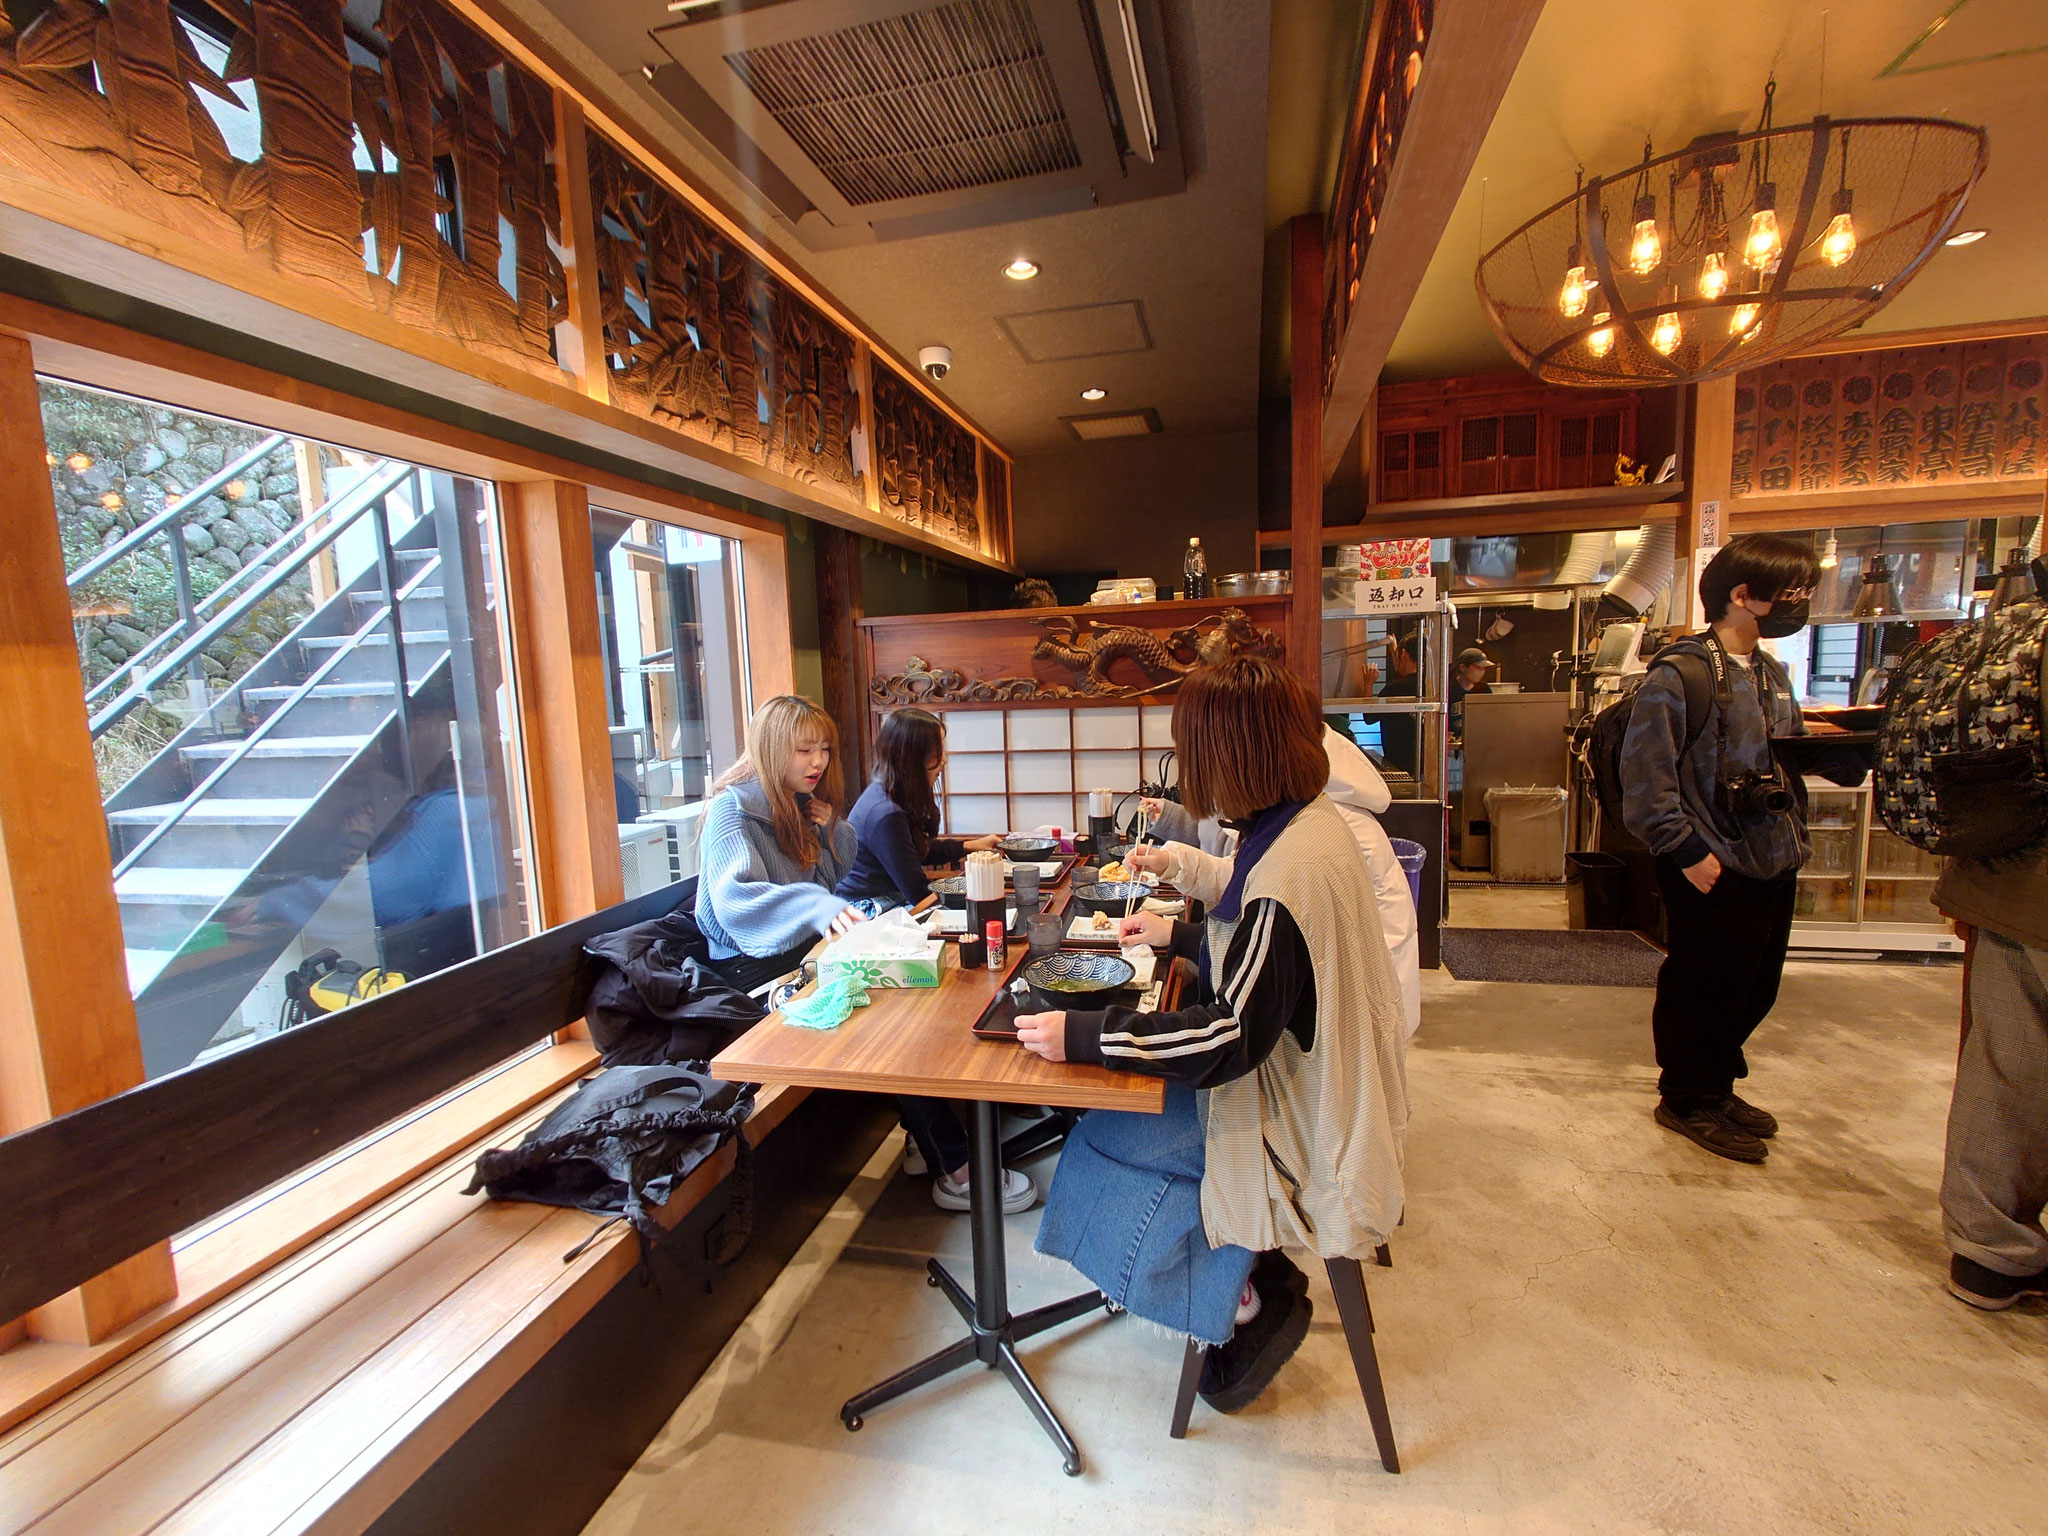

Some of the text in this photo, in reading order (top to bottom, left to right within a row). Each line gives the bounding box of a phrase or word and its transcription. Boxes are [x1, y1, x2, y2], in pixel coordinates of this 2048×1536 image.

[1368, 586, 1424, 603] 返却口
[1712, 652, 1724, 682] DIGITAL
[902, 975, 934, 984] ellemoi
